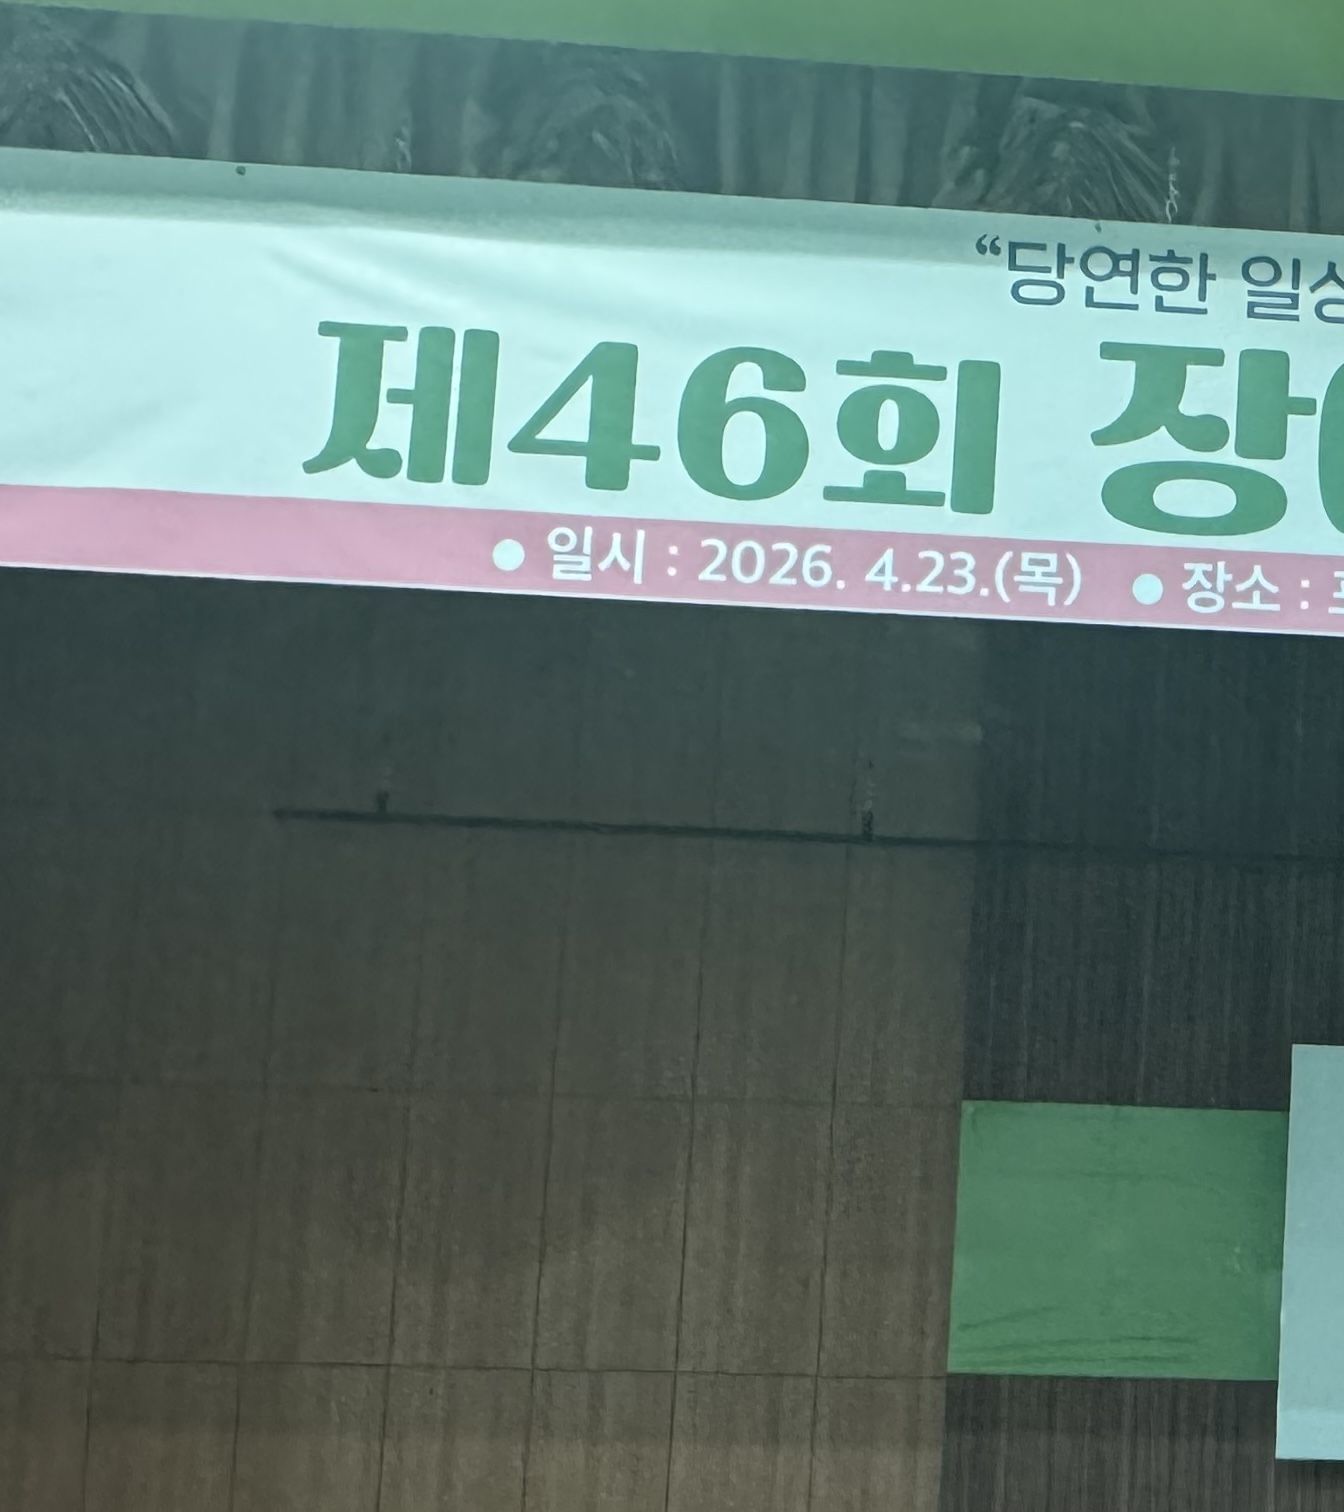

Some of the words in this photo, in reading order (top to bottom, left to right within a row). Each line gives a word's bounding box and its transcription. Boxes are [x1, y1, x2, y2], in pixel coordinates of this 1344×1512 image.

[302, 320, 1002, 515] 제46회
[546, 525, 646, 584] 일시
[698, 537, 847, 590] 2026.
[864, 546, 1082, 606] 4.23.(목)
[1181, 559, 1281, 614] 장소
